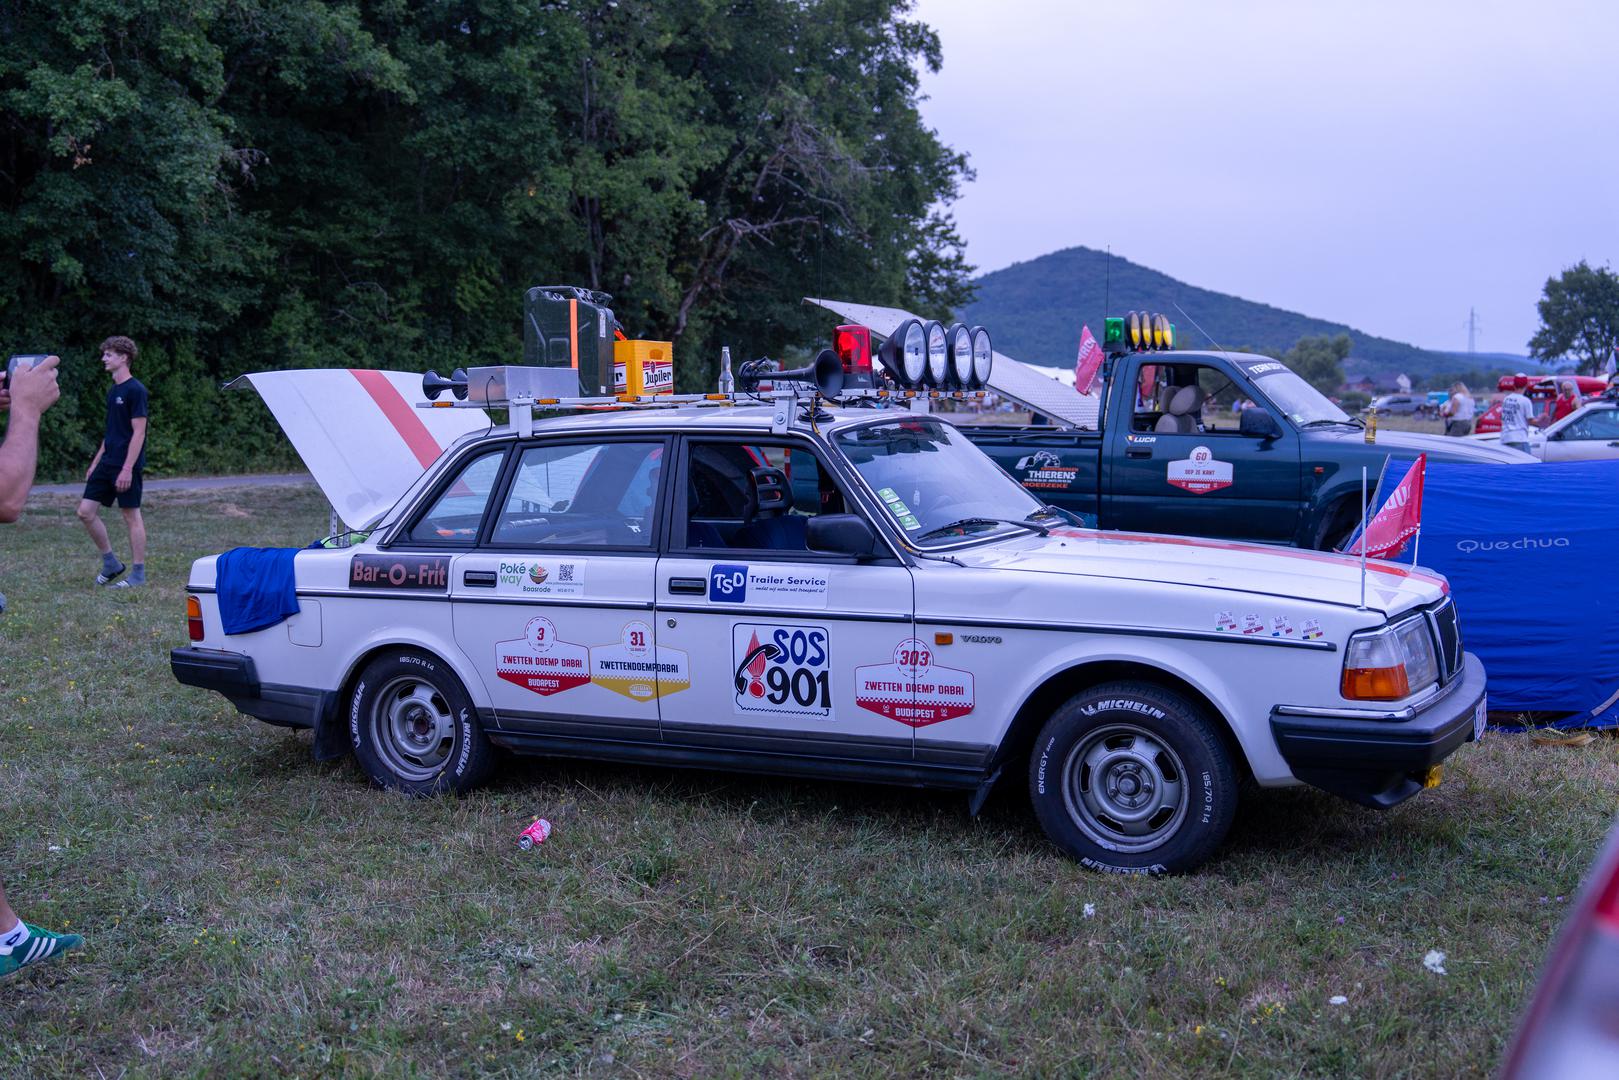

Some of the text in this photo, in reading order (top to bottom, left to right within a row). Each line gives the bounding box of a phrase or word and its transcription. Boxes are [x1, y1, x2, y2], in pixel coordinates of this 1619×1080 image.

[644, 370, 672, 386] Jupiler
[1195, 452, 1208, 461] 60
[1028, 470, 1077, 480] THIERENS
[1456, 537, 1570, 553] Quechua
[353, 559, 446, 586] Bar-O-Frit
[500, 562, 527, 575] Poké
[500, 575, 523, 587] way
[713, 571, 745, 594] TSD
[749, 575, 827, 586] Trailer Service
[537, 627, 545, 641] 3
[630, 631, 646, 646] 31
[960, 635, 1003, 644] VOLVO
[773, 628, 826, 667] SOS
[502, 655, 533, 666] ZWETTEN
[535, 657, 559, 667] DOEMP
[899, 649, 931, 667] 303
[527, 678, 560, 688] BUDAPEST
[766, 666, 832, 708] 901
[864, 680, 903, 692] ZWETTEN
[905, 683, 935, 694] DOEMP
[351, 681, 366, 735] MICHELIN
[895, 707, 935, 719] BUDAPEST
[1097, 699, 1166, 719] MICHELIN
[455, 722, 471, 777] MICHELIN
[1038, 751, 1049, 794] ENERGY
[1201, 771, 1213, 803] 185/70
